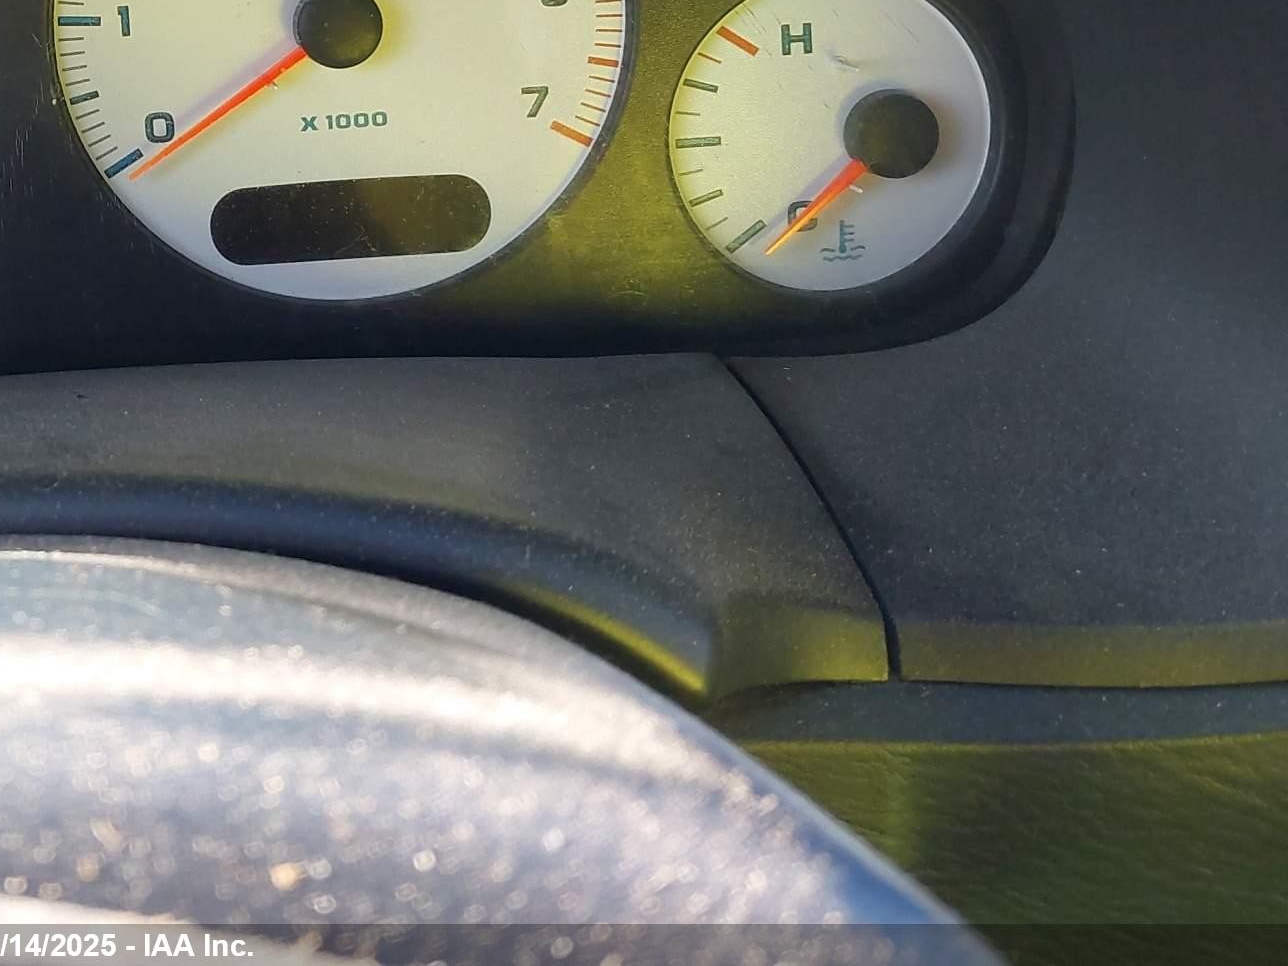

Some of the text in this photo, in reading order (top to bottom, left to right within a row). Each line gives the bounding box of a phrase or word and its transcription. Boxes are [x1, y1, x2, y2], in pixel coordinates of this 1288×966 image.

[117, 6, 131, 37] 1
[781, 23, 813, 55] H
[521, 85, 549, 118] 7
[145, 111, 176, 143] 0
[300, 111, 388, 132] X 1000
[788, 200, 818, 232] C
